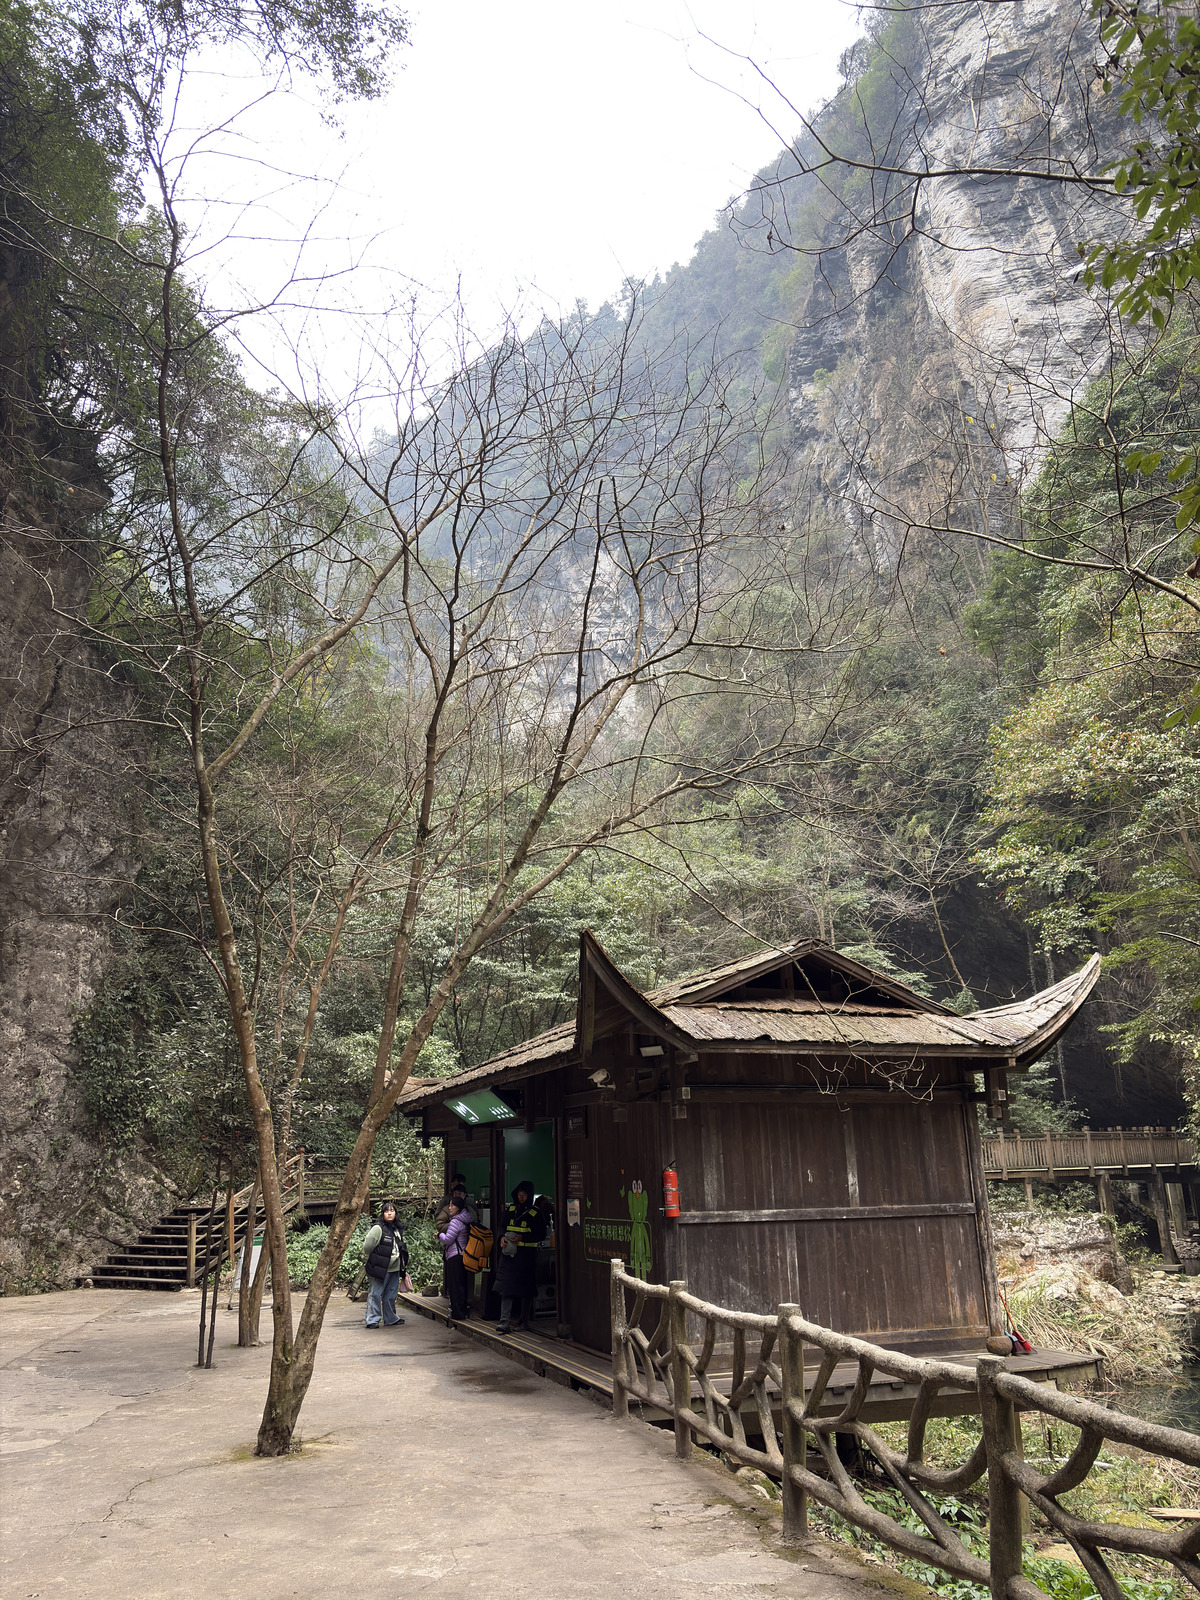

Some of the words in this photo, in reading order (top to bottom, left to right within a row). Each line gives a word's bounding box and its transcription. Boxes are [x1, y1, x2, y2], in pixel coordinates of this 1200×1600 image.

[585, 1224, 631, 1242] 我在张家界很想你
